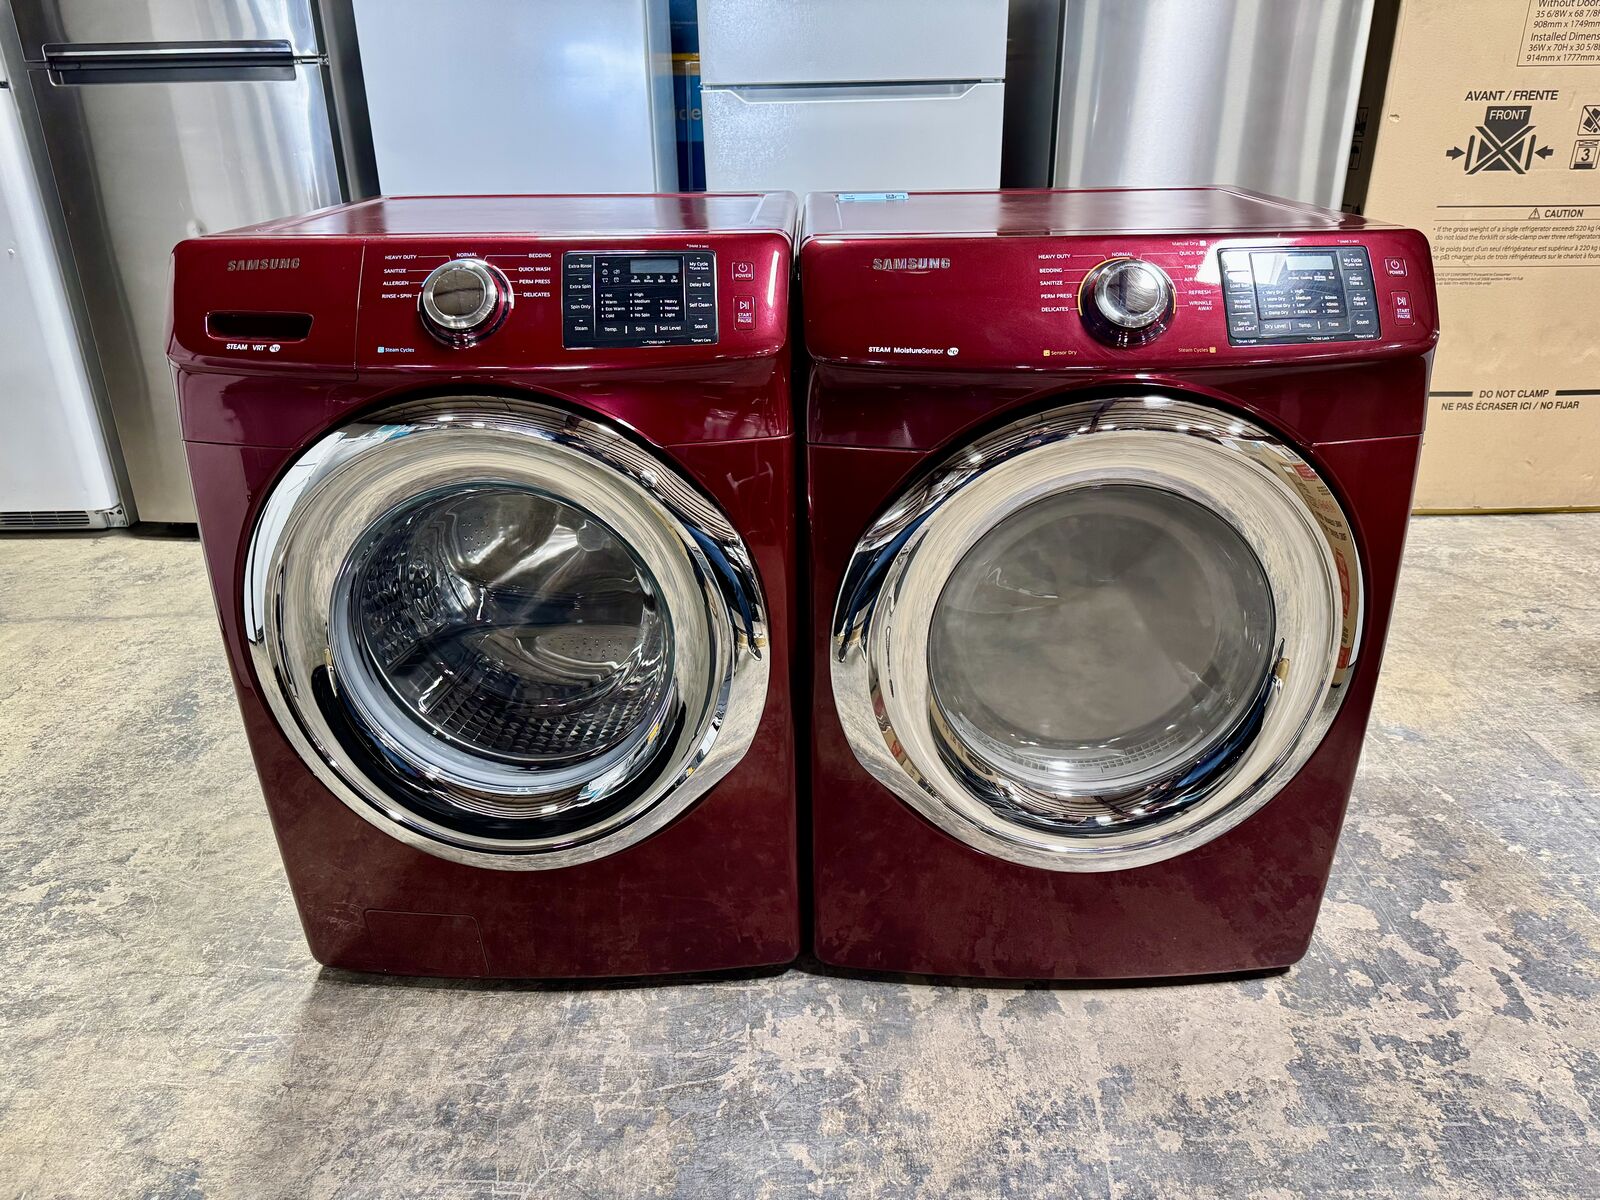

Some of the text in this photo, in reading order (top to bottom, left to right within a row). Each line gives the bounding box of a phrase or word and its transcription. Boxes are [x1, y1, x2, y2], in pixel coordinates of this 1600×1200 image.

[1530, 32, 1567, 41] Installed
[1465, 90, 1559, 101] AVANT / FRENTE
[1489, 110, 1527, 120] FRONT
[1581, 148, 1590, 162] 3
[1544, 209, 1584, 218] CAUTION
[227, 258, 300, 271] SAMSUNG
[872, 258, 951, 270] SAMSUNG
[1479, 390, 1550, 398] DO NOT CLAMP
[1441, 402, 1454, 410] NE
[1456, 402, 1474, 410] PAS
[1476, 400, 1518, 410] ÉCRASER
[1540, 402, 1554, 410] NO
[1555, 401, 1580, 410] FIJAR
